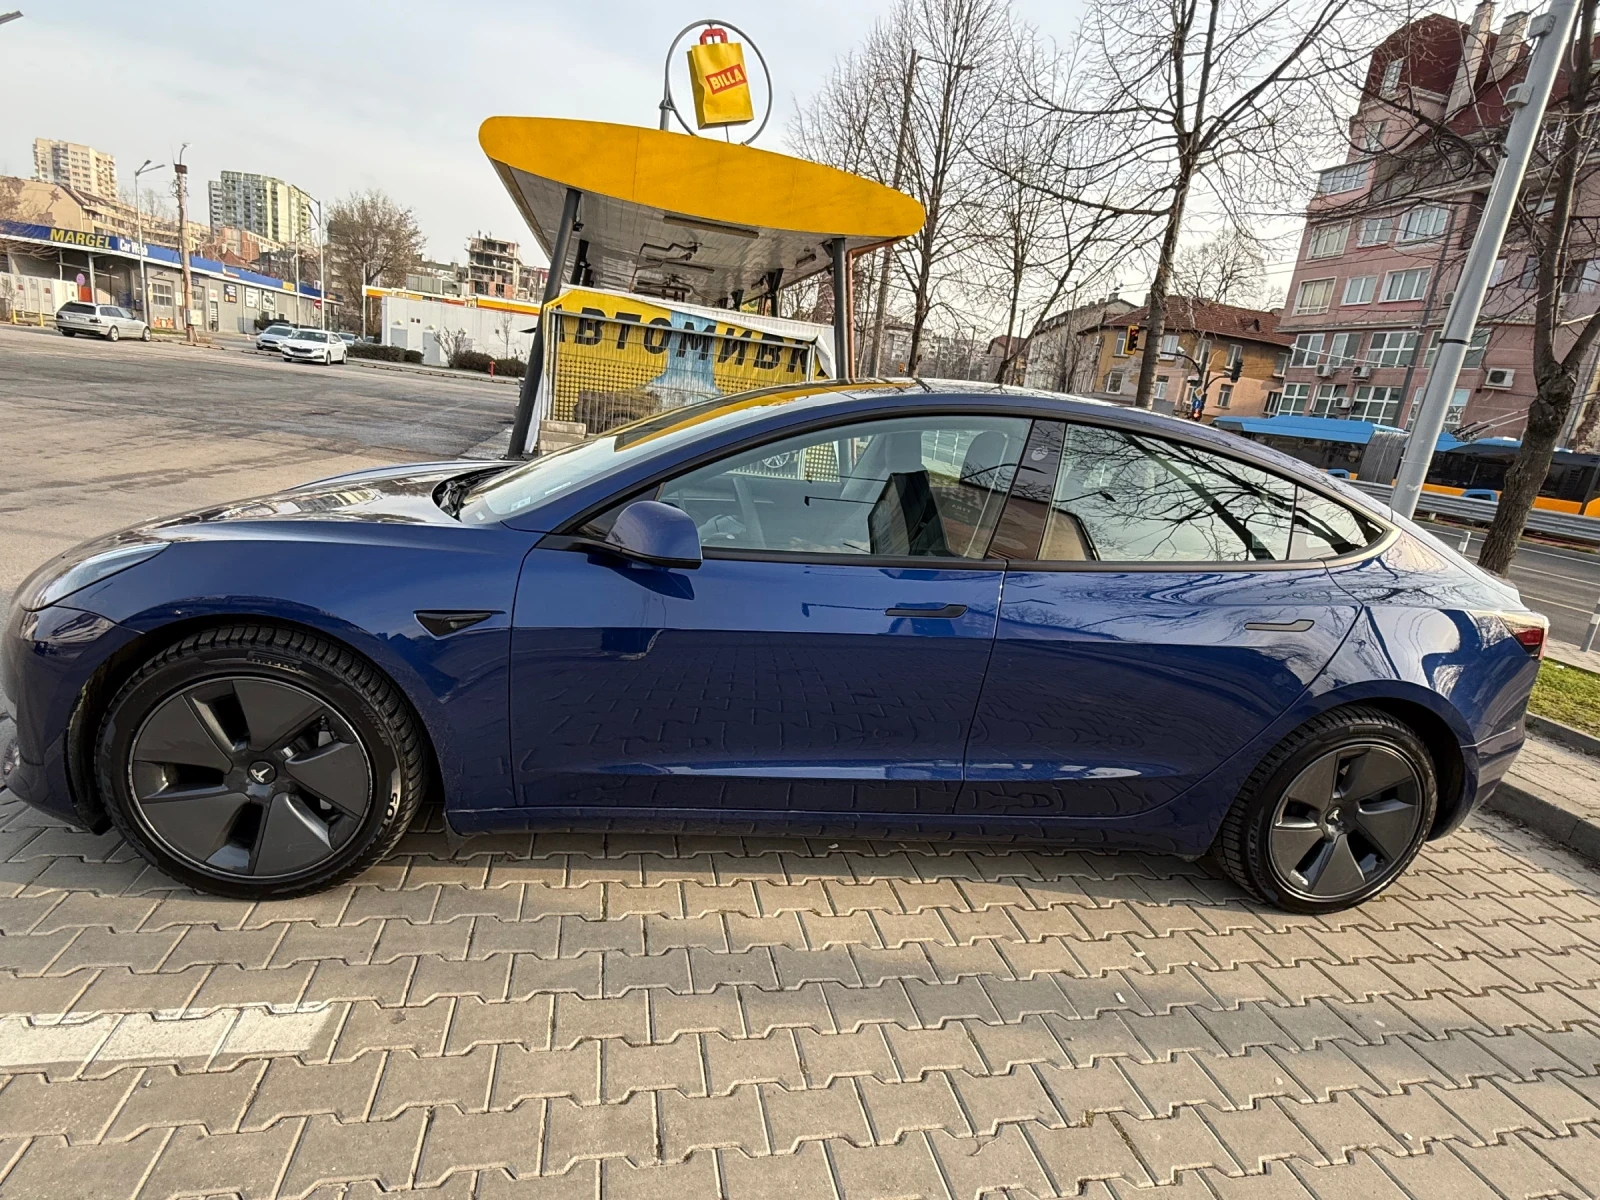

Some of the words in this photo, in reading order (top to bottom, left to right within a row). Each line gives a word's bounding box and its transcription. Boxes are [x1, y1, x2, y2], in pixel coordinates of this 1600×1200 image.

[710, 68, 744, 90] BILLA
[50, 228, 112, 249] MARGEL
[119, 238, 131, 253] Car
[553, 304, 826, 378] АВТОМИВК
